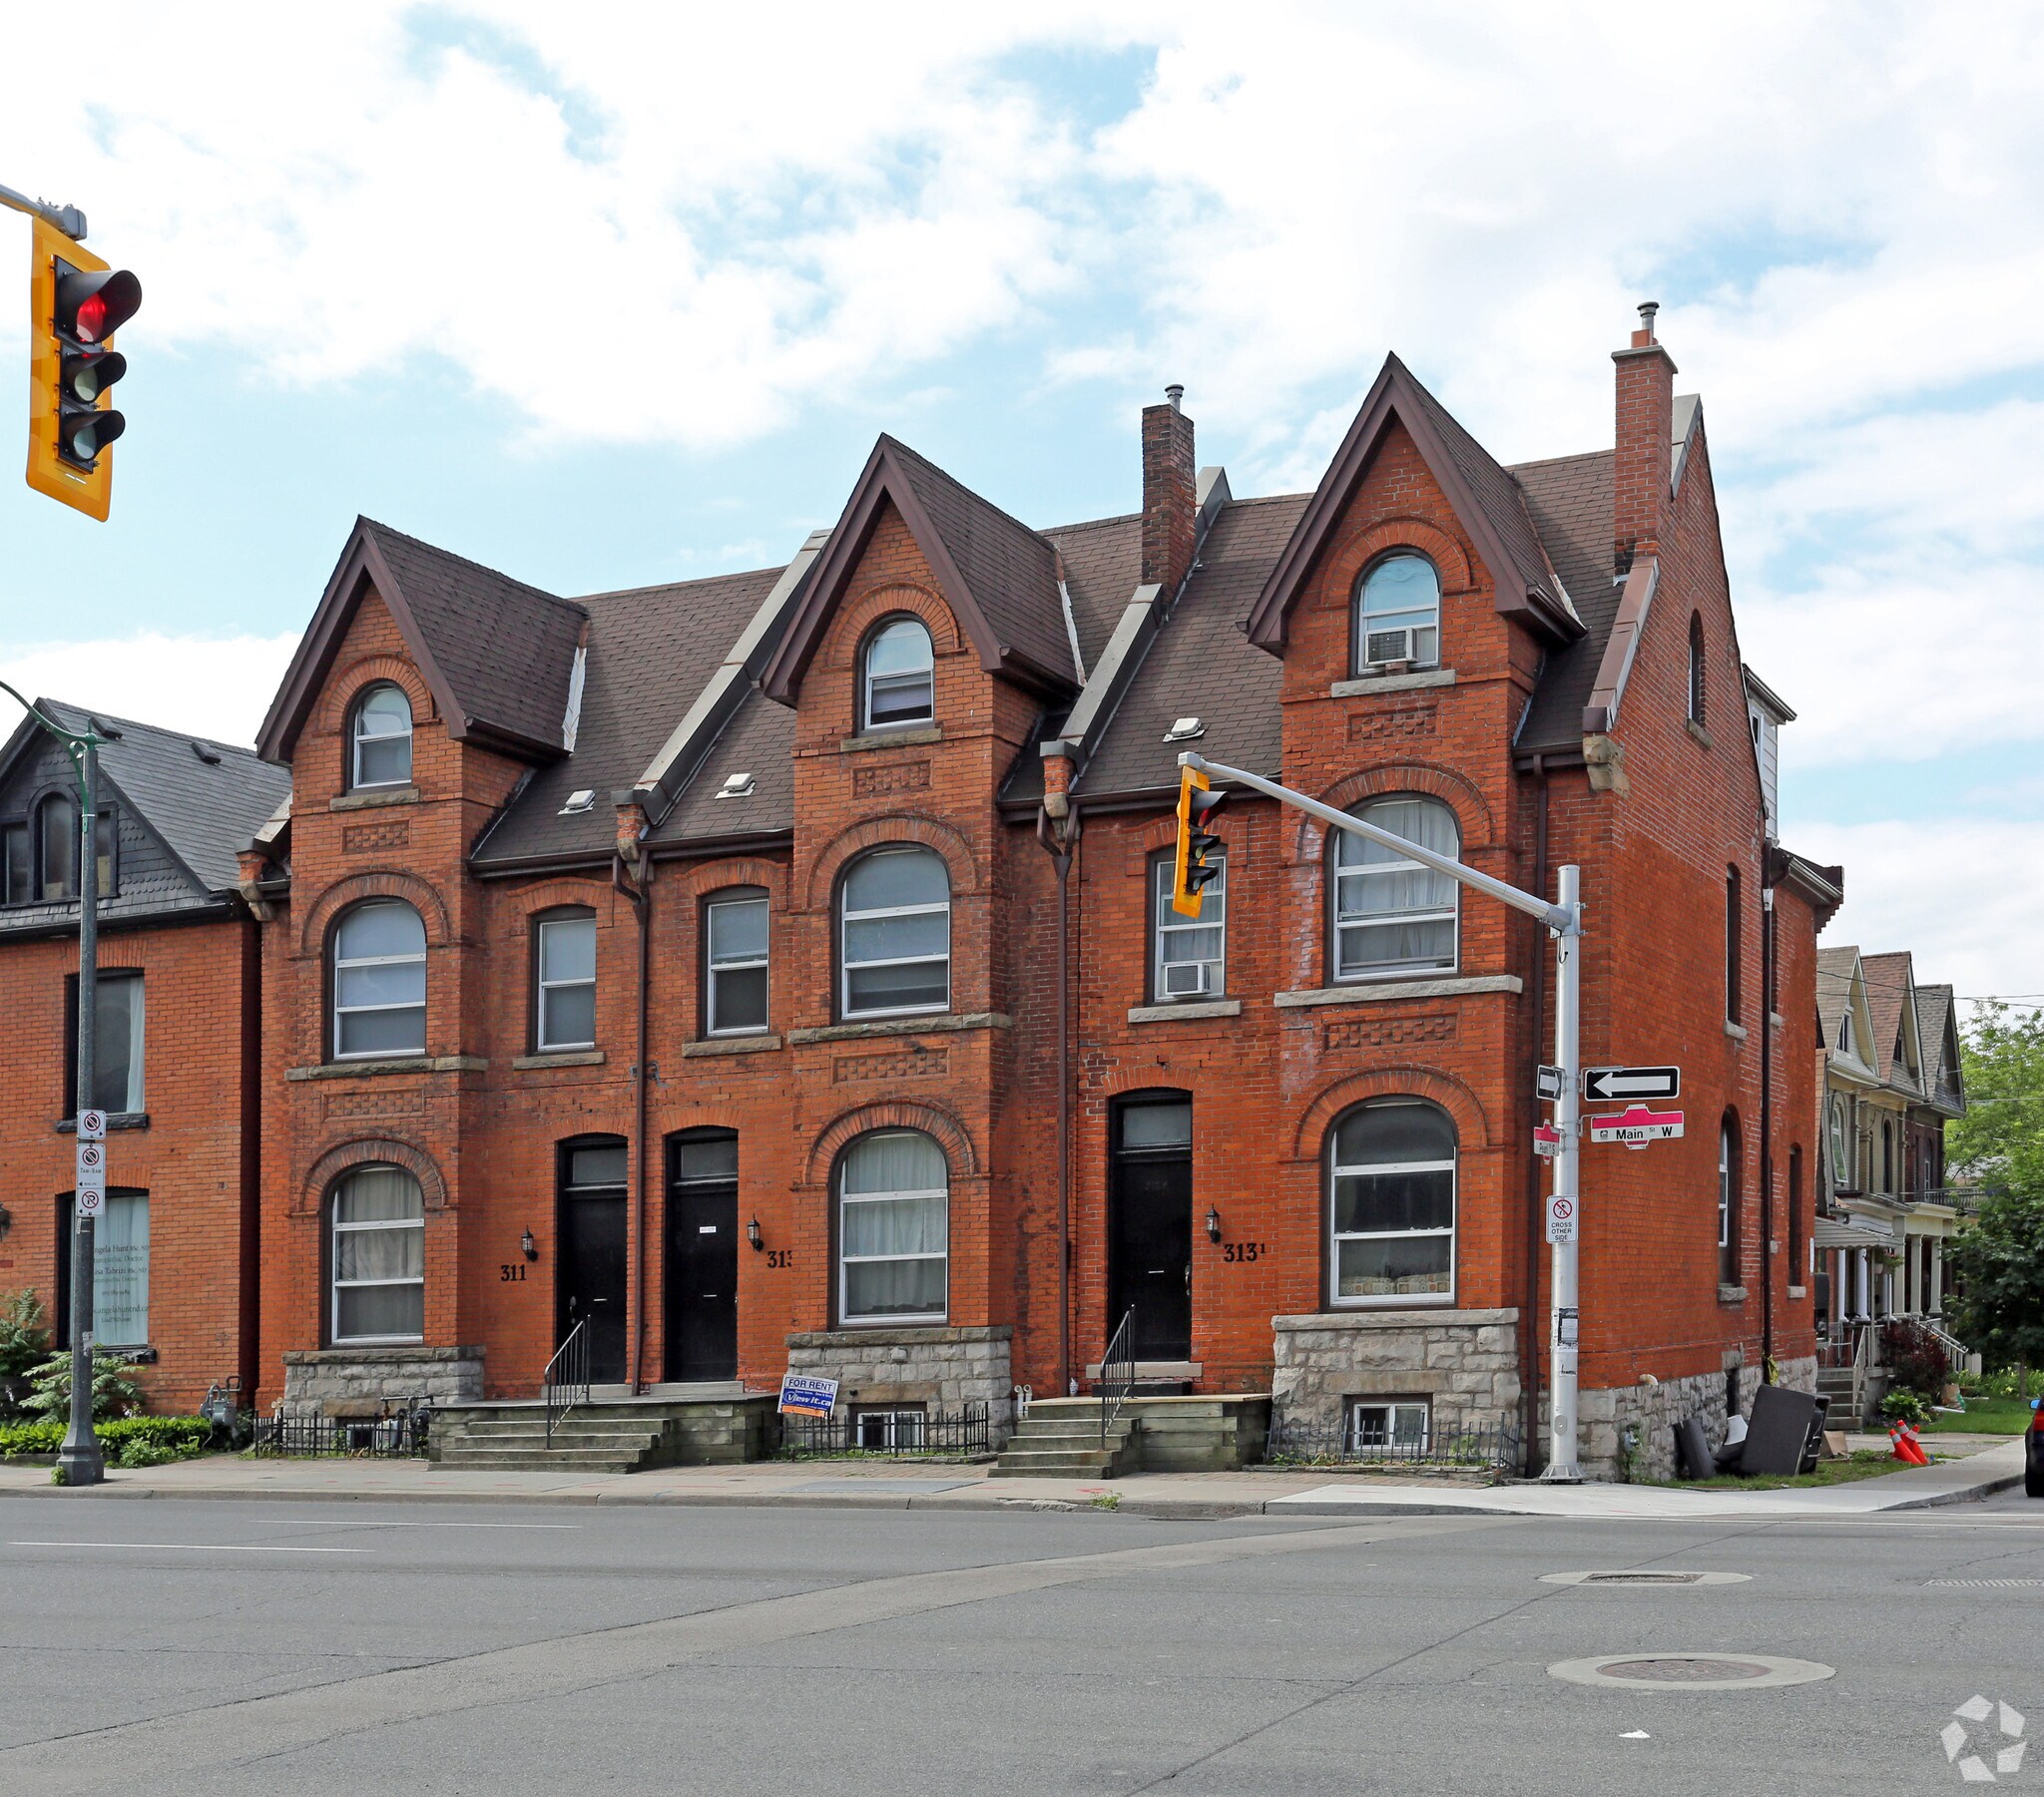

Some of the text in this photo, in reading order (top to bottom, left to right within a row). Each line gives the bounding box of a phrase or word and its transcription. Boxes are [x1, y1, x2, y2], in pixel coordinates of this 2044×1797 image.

[1617, 1128, 1644, 1139] Main
[1661, 1126, 1673, 1136] W
[94, 1244, 111, 1254] ngela
[500, 1264, 527, 1281] 311
[788, 1378, 832, 1391] FOR RENT
